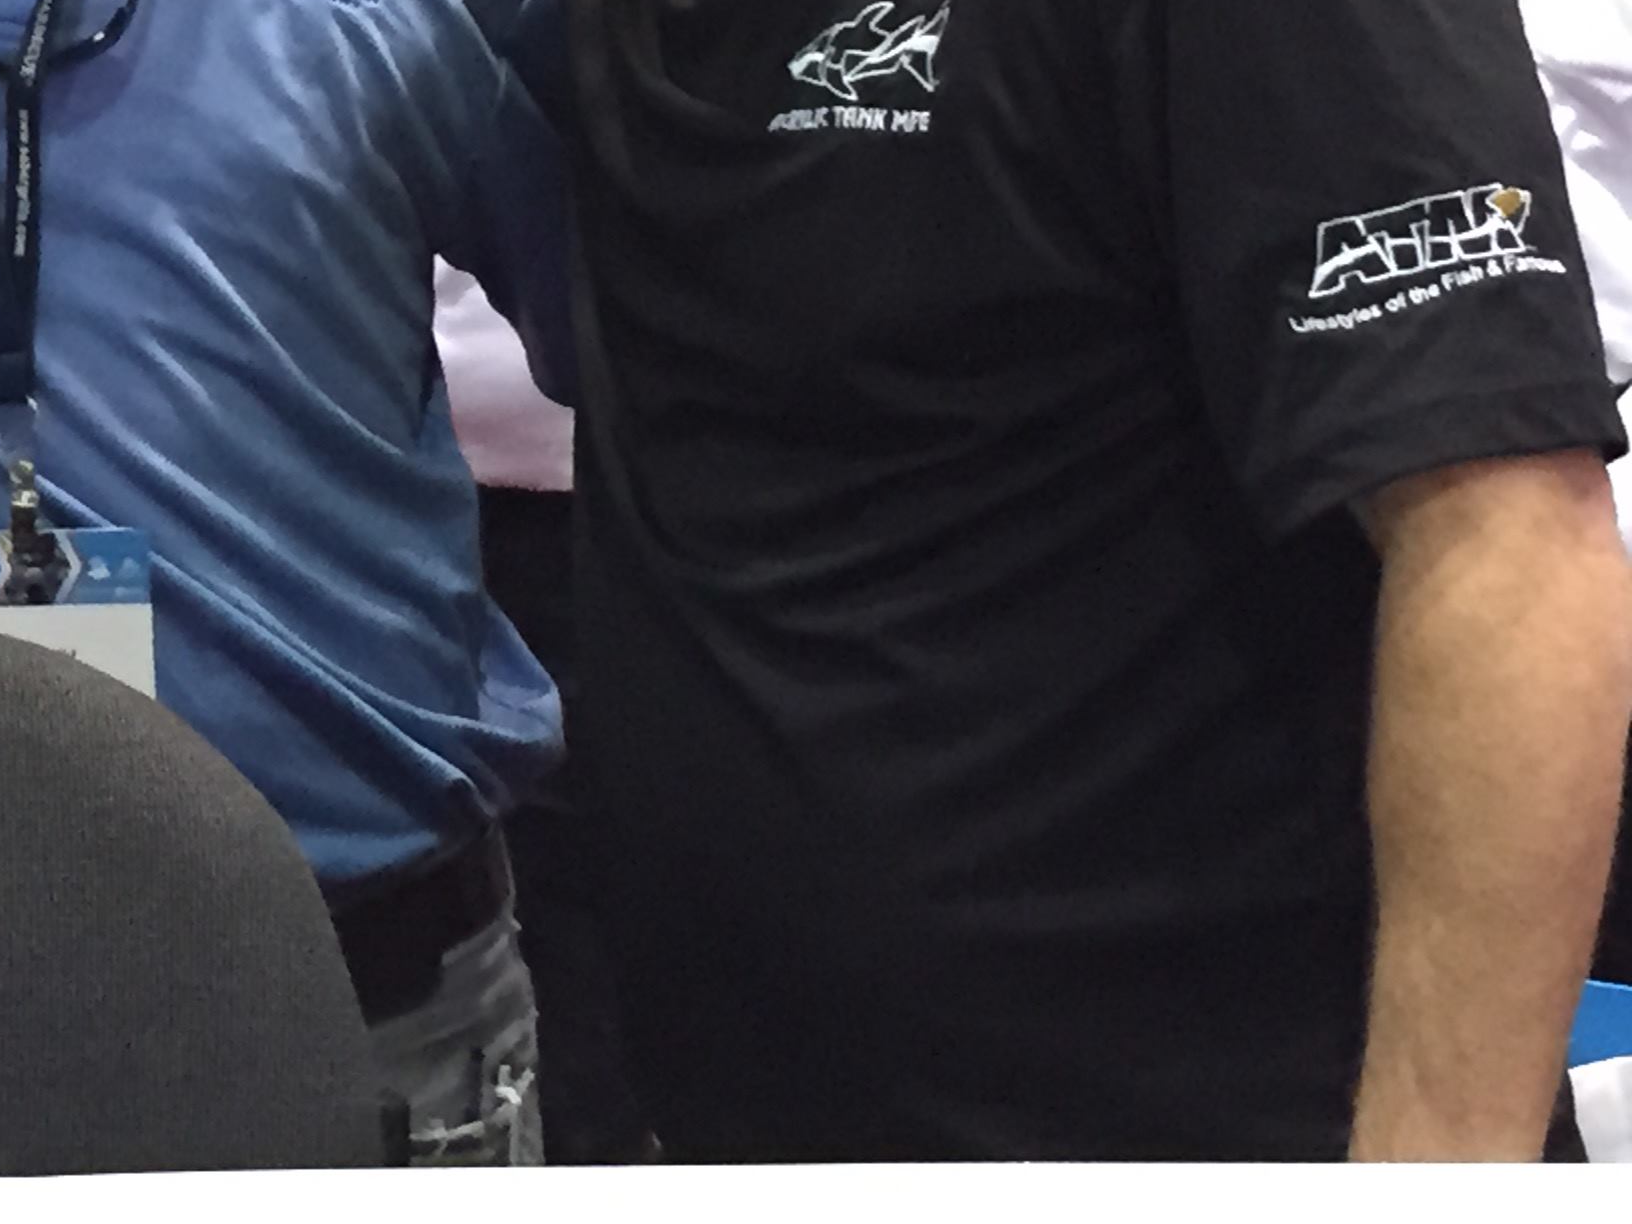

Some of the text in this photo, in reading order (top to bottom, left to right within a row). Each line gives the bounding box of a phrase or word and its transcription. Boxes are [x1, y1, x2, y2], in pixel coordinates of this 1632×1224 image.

[832, 105, 887, 130] TANK
[1385, 292, 1407, 312] of
[1409, 284, 1440, 304] the
[1441, 265, 1484, 291] Fish
[1487, 258, 1504, 277] &
